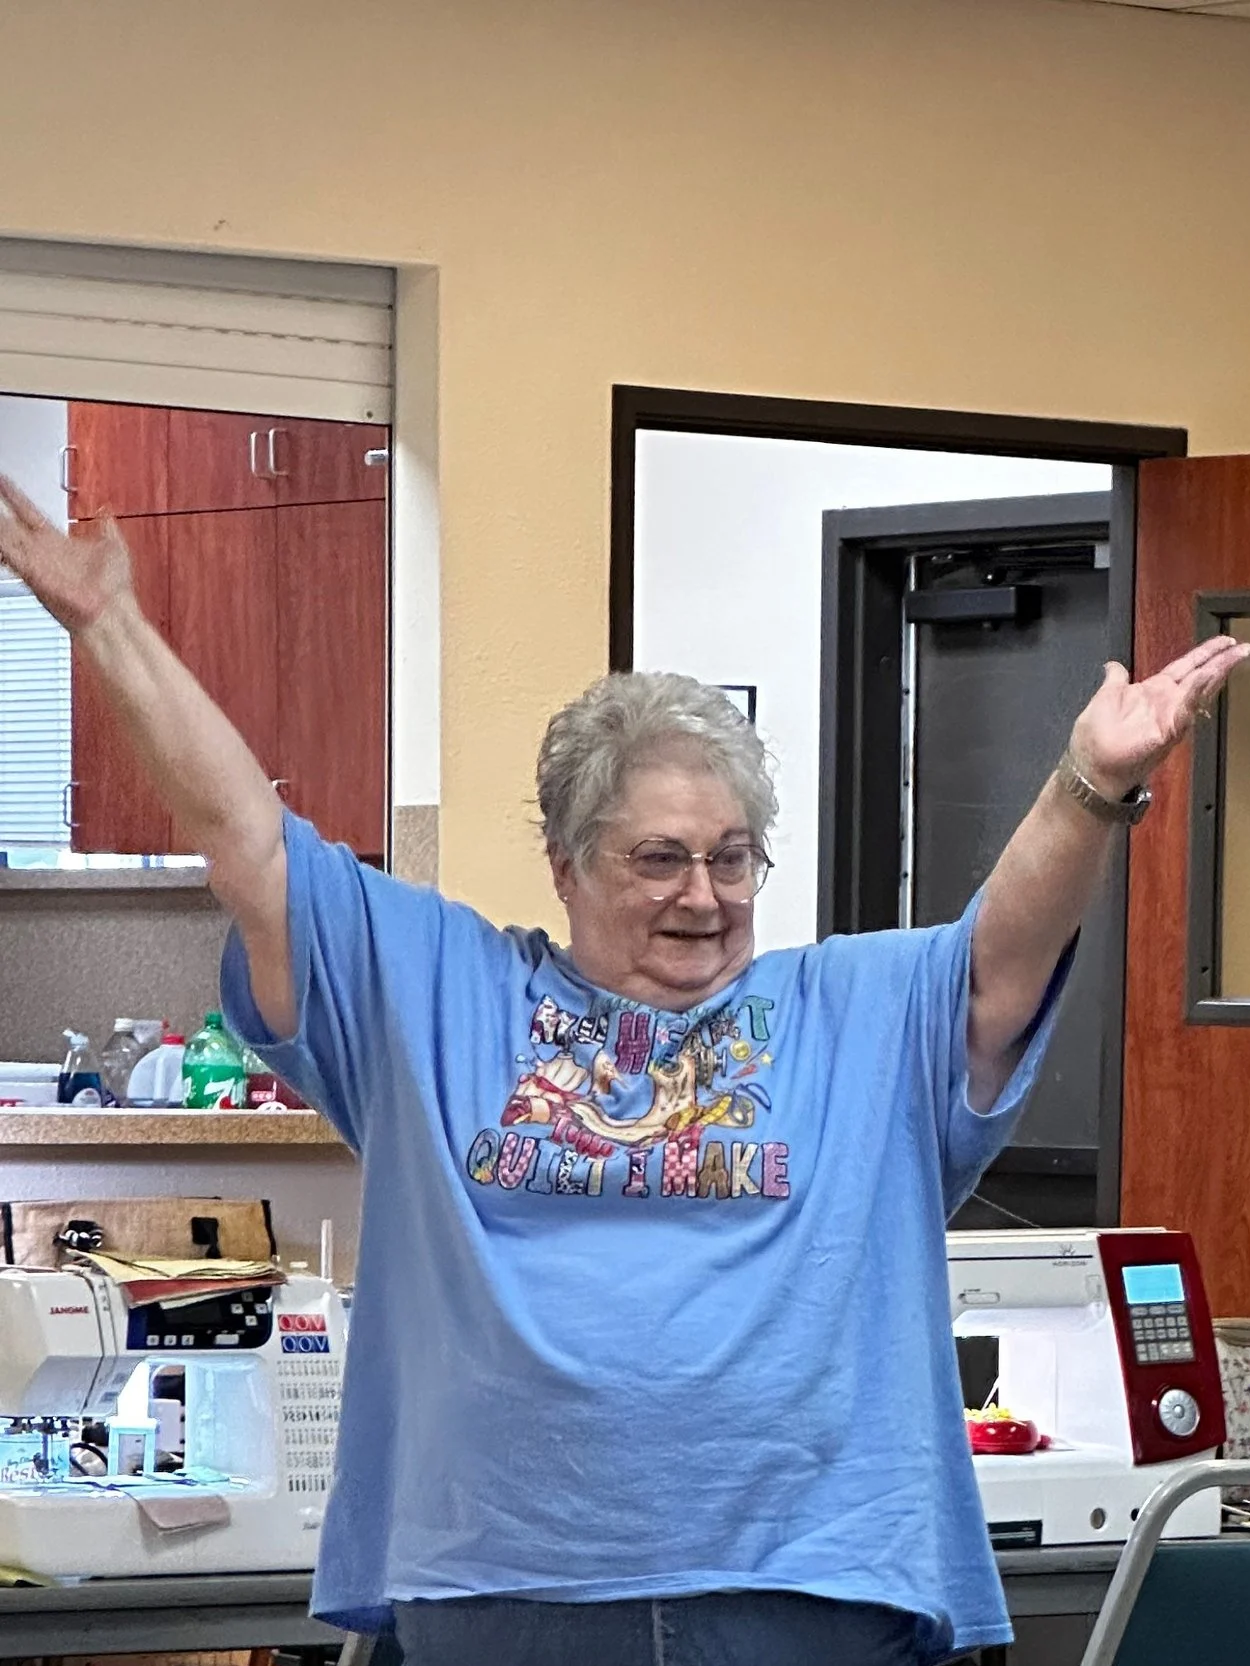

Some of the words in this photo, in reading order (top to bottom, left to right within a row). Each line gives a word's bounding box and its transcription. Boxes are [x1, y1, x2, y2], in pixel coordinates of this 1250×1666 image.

[615, 995, 774, 1074] HET
[467, 1128, 610, 1198] QUILT
[624, 1147, 653, 1198] I
[661, 1141, 791, 1200] MAKE
[49, 1305, 89, 1315] JANOME
